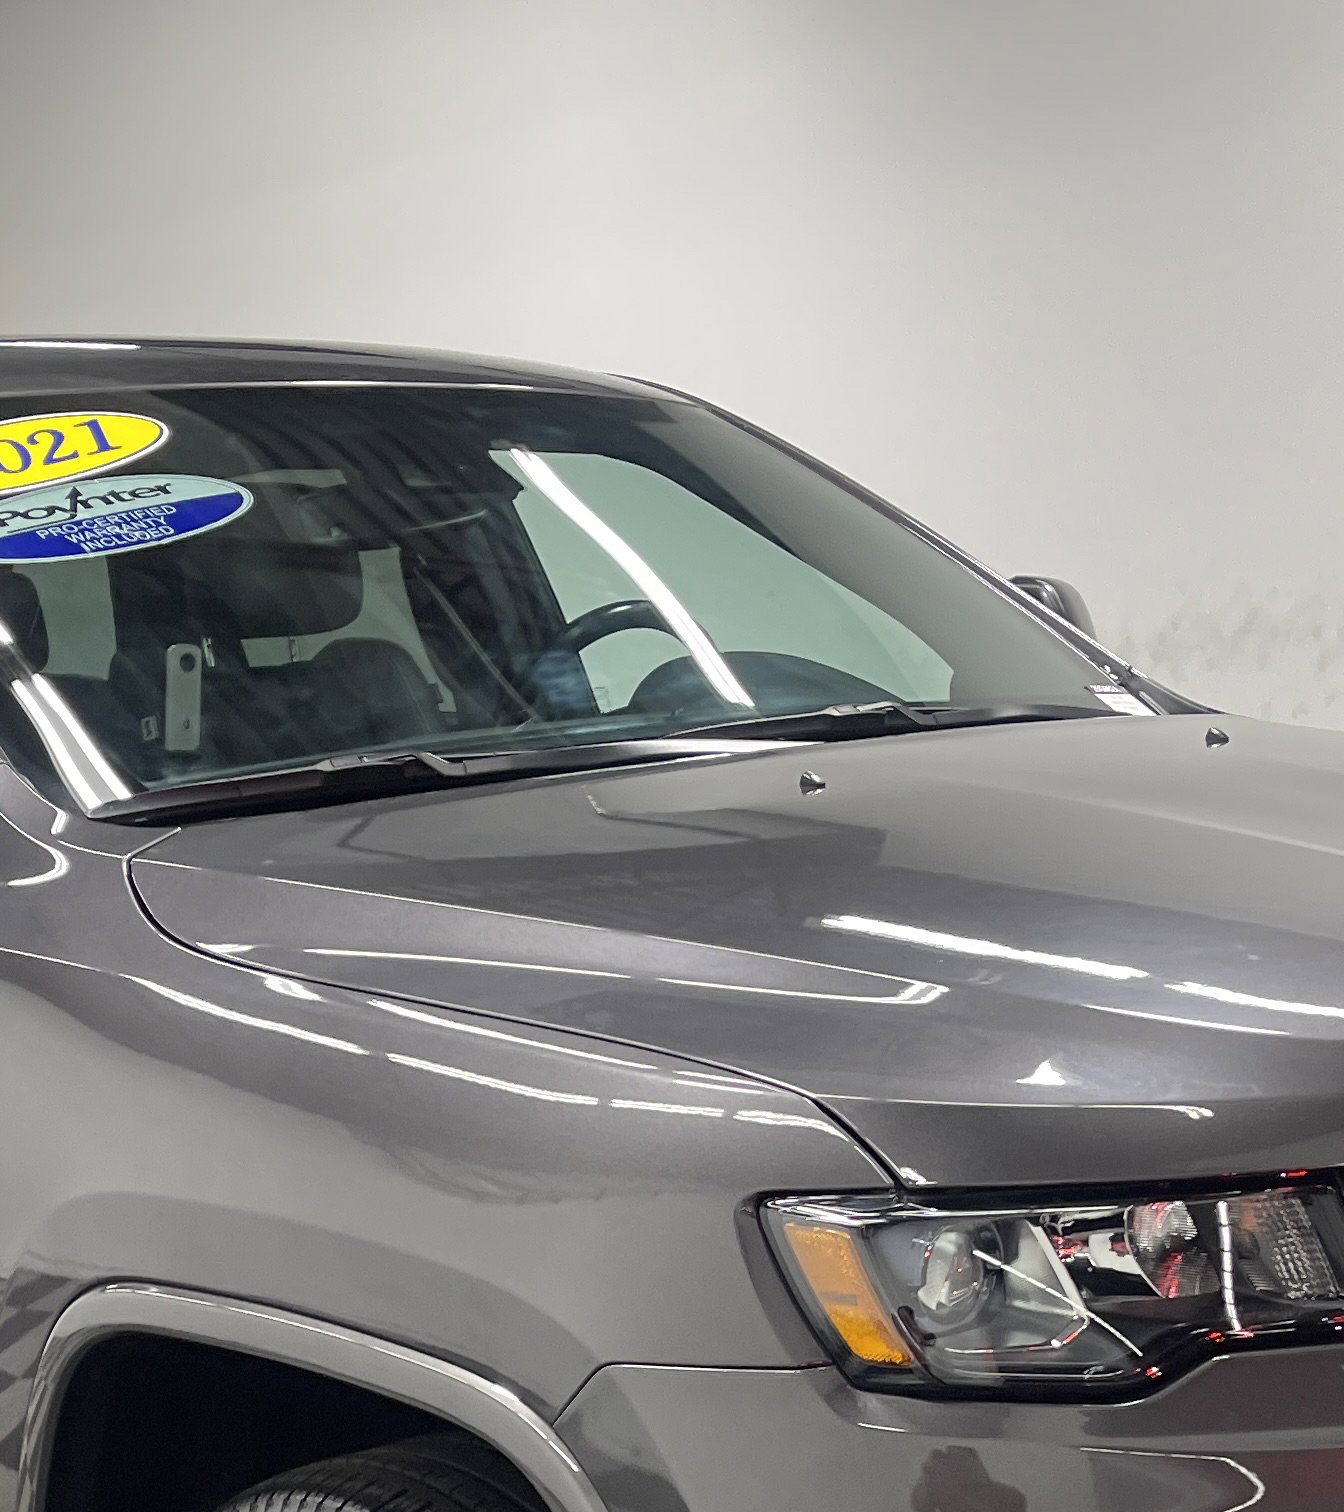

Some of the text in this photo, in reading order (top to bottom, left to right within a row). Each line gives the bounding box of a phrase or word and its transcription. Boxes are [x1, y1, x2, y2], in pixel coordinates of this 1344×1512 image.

[35, 504, 177, 540] PRO-CERTIFIED
[64, 515, 169, 545] WARRANTY
[79, 525, 175, 554] INCLUDED
